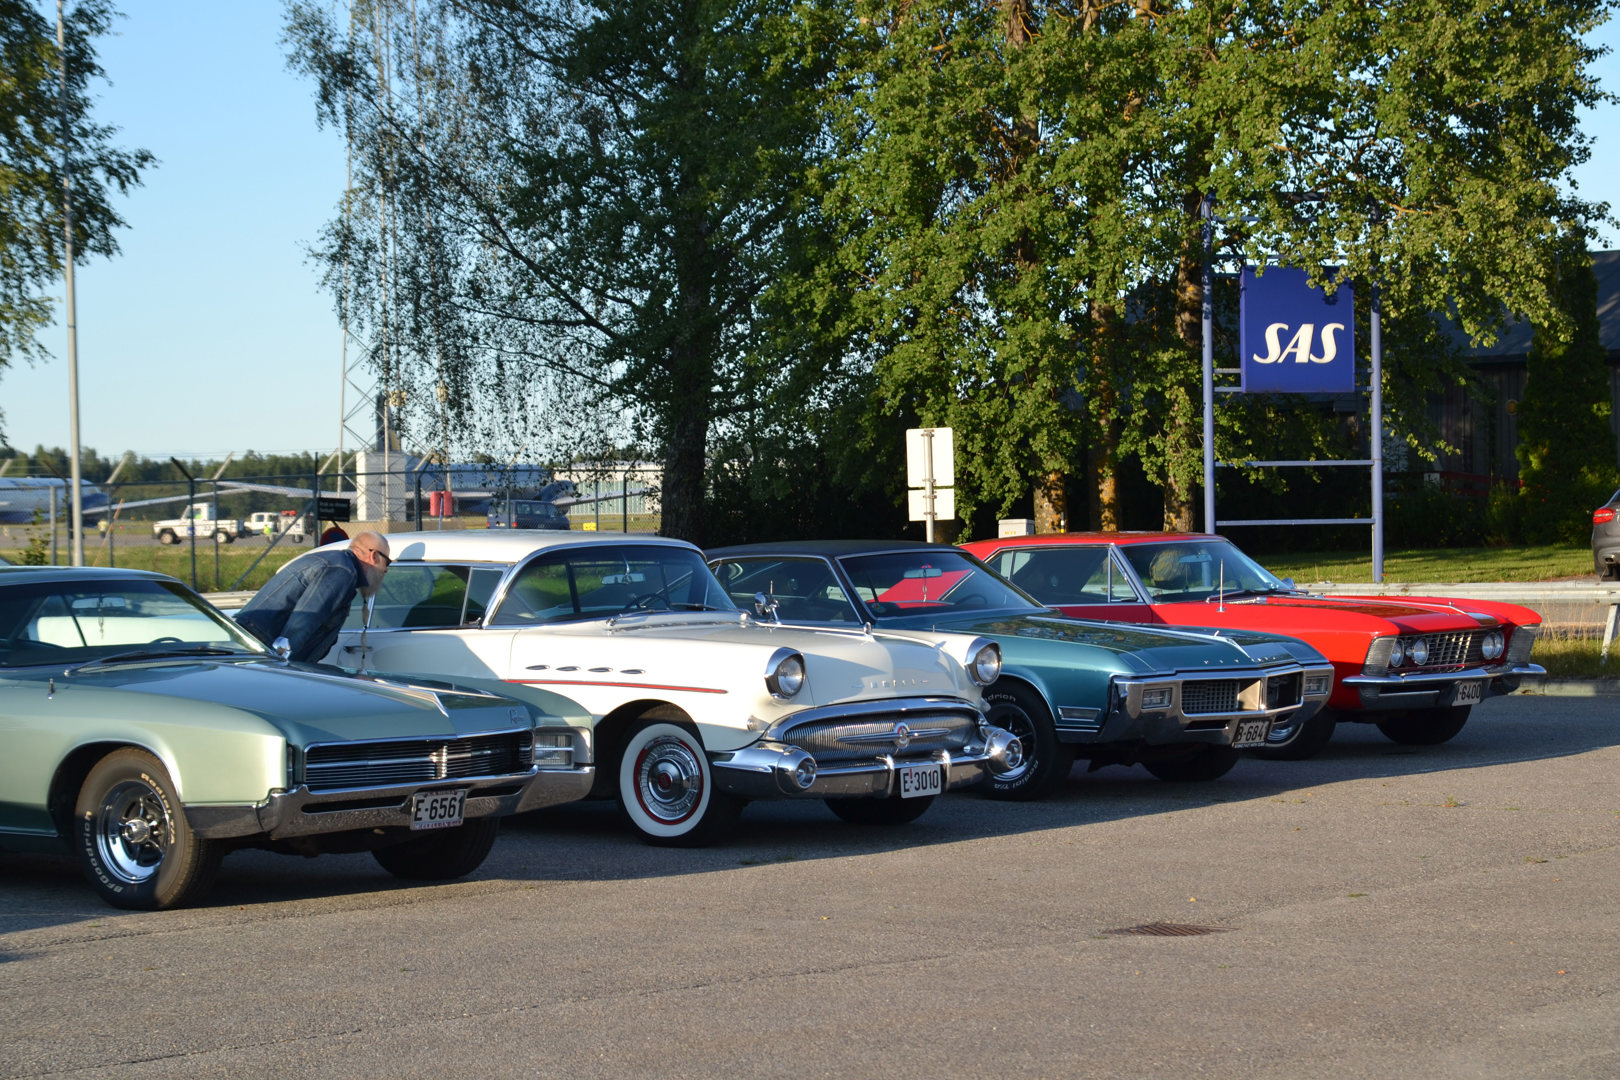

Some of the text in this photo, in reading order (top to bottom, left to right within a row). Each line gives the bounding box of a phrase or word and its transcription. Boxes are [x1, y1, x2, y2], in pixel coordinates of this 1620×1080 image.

[1252, 322, 1345, 364] SAS
[141, 772, 172, 815] Radial
[413, 795, 465, 822] E-6561
[84, 810, 124, 893] BFGoodrich
